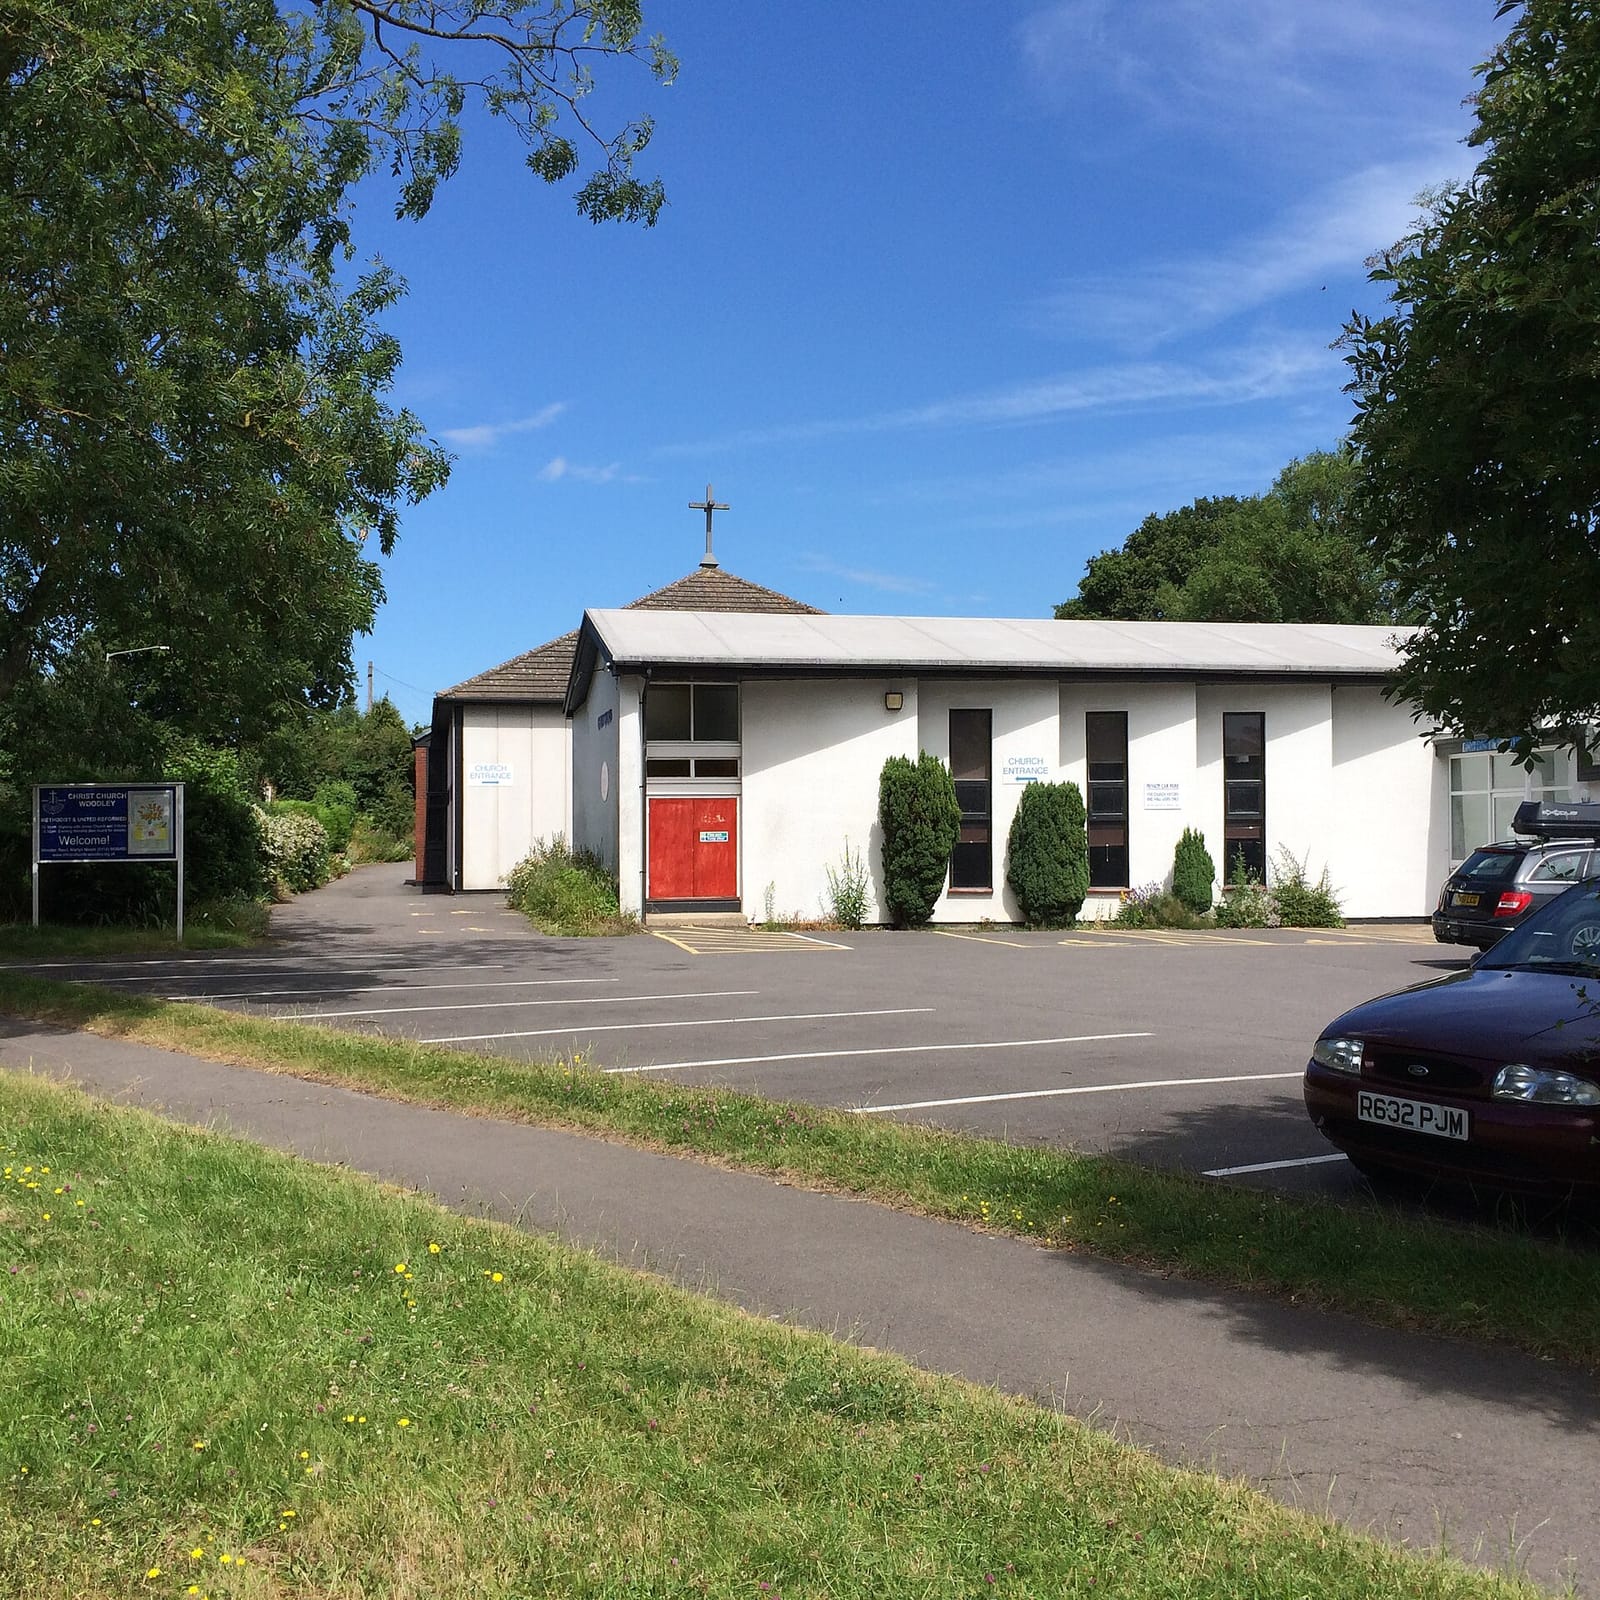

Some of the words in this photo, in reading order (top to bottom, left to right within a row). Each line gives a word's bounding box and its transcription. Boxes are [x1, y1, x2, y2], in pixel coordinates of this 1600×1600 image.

[1008, 757, 1044, 765] CHURCH
[475, 764, 508, 772] CHURCH
[1002, 766, 1049, 775] ENTRANCE
[470, 772, 512, 780] ENTRANCE
[96, 792, 127, 800] CHURCH
[58, 835, 110, 846] Welcome!
[1360, 1095, 1414, 1126] R632
[1419, 1106, 1463, 1136] PJM
